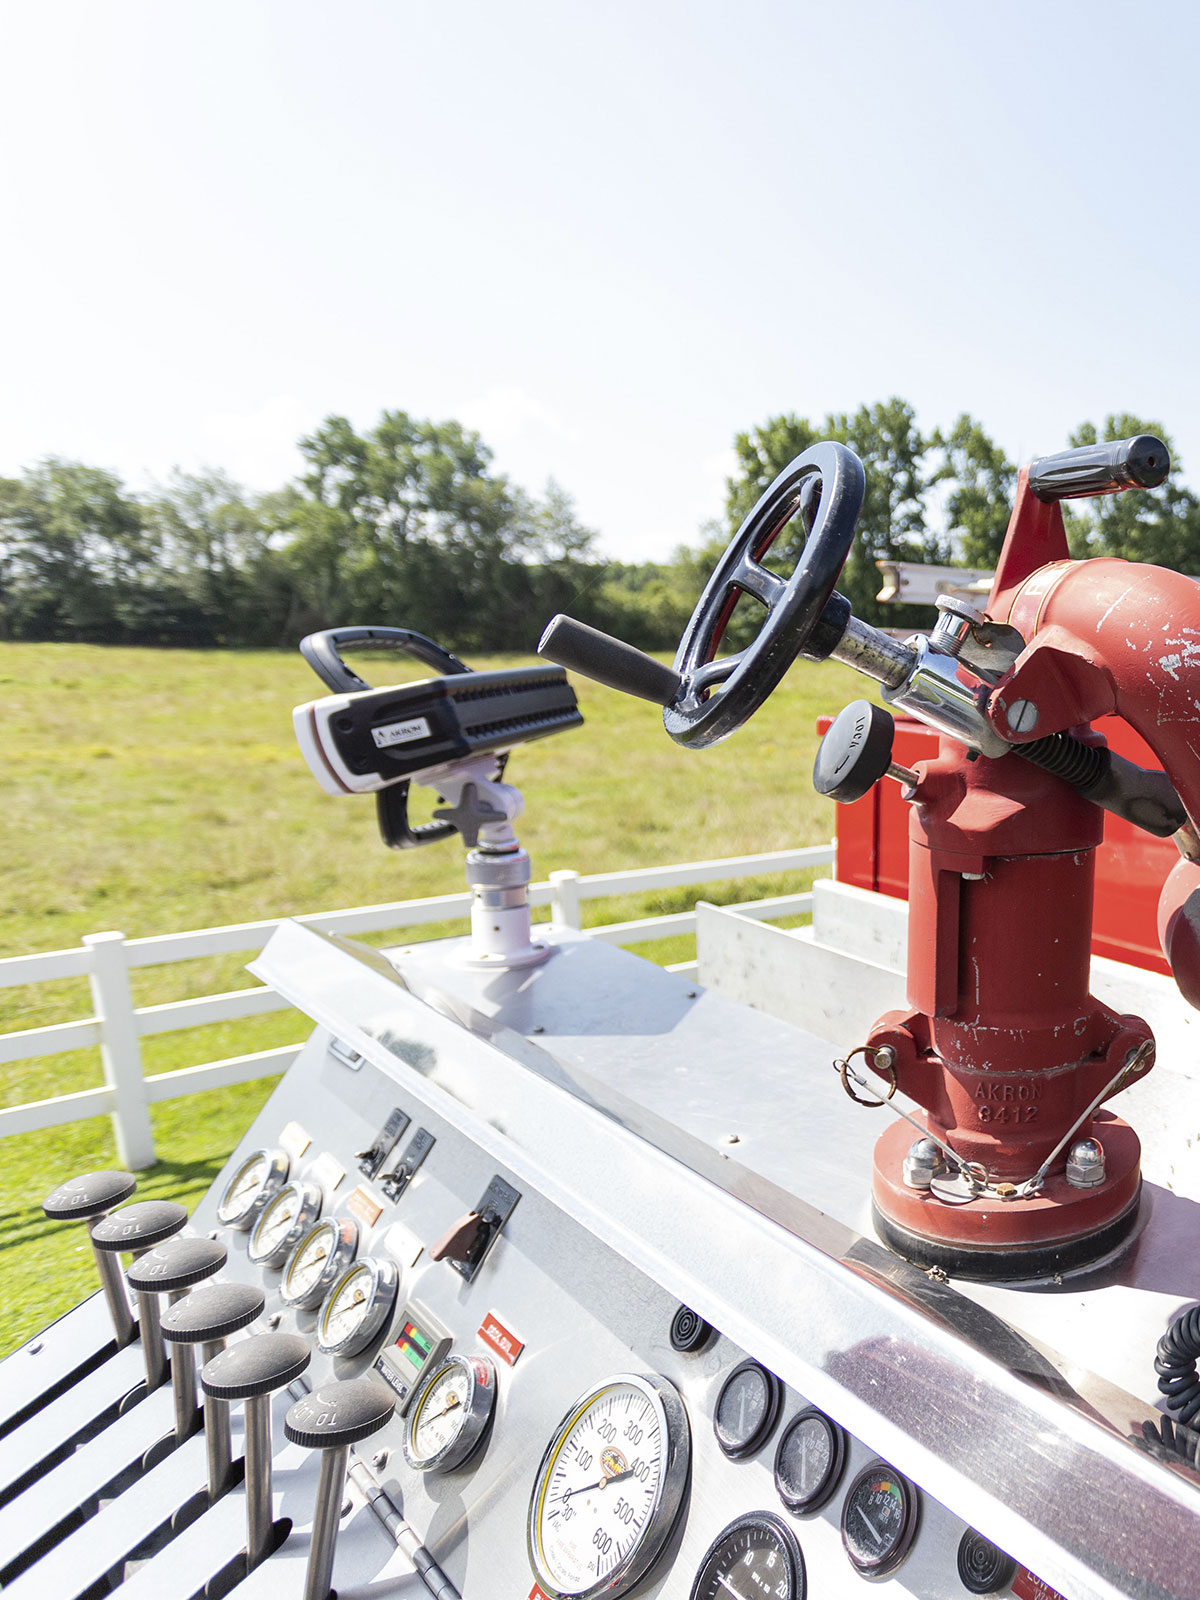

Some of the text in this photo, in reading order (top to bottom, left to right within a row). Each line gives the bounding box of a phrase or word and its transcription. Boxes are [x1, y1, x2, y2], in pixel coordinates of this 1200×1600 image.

[849, 716, 866, 749] LOCK
[974, 1082, 1043, 1101] AKRON
[315, 1412, 337, 1427] TO
[597, 1418, 617, 1444] 200
[623, 1420, 644, 1446] 300
[575, 1446, 593, 1471] 100
[631, 1457, 651, 1483] 400
[868, 1494, 875, 1505] 8
[875, 1493, 883, 1505] 10
[882, 1493, 891, 1505] 12
[889, 1498, 897, 1510] 14
[613, 1496, 634, 1525] 500
[592, 1527, 612, 1555] 600
[744, 1549, 754, 1566] 10
[766, 1550, 777, 1568] 15
[751, 1571, 761, 1583] RPM
[775, 1580, 788, 1599] 20
